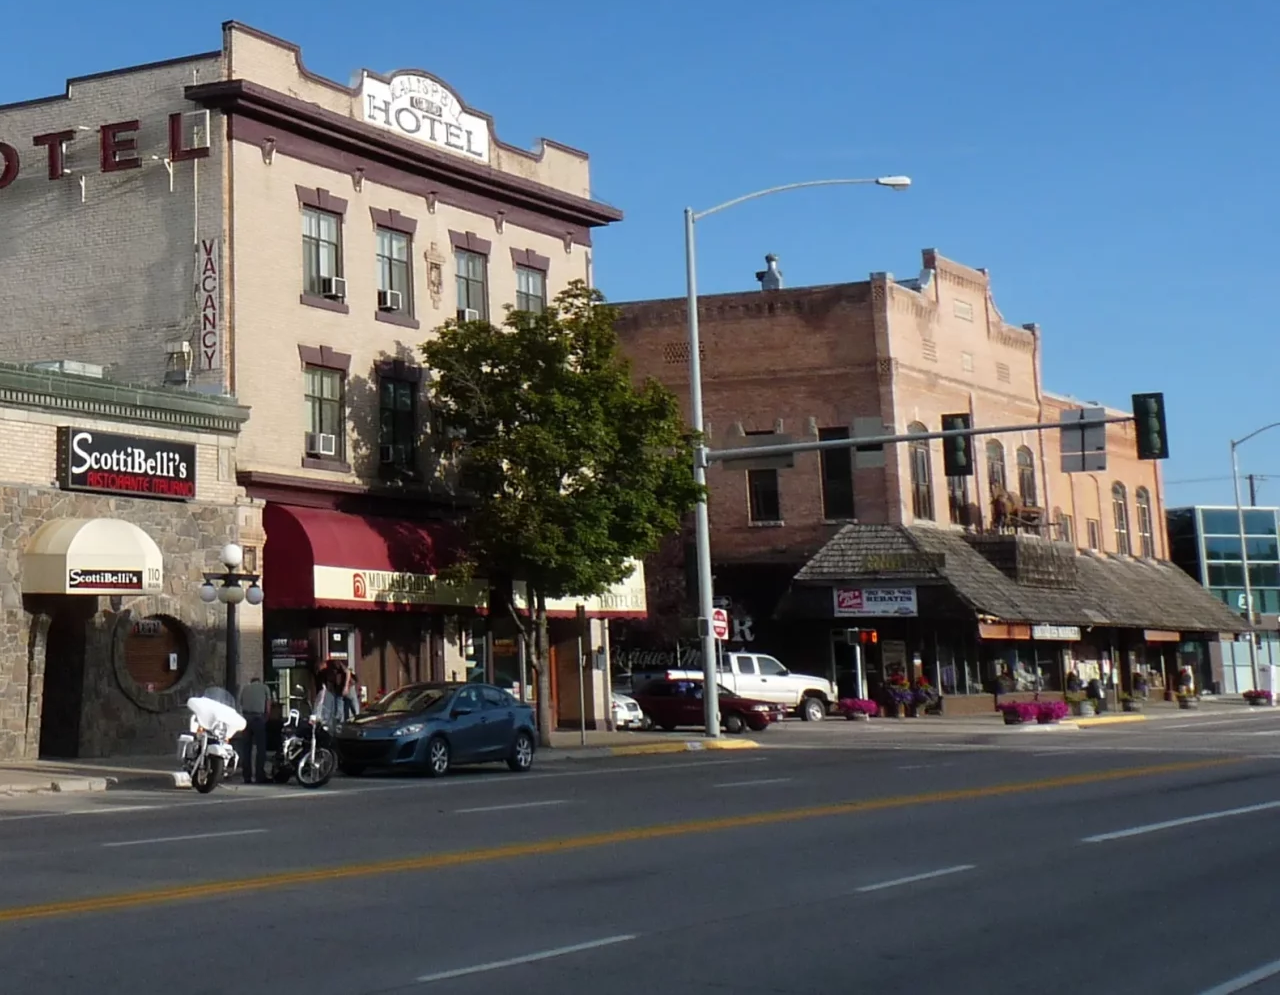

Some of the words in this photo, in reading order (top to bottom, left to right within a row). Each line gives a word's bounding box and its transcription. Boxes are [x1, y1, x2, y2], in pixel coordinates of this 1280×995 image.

[367, 94, 483, 158] HOTEL
[201, 239, 218, 371] VACANCY
[71, 432, 187, 479] ScottiBelli's
[87, 472, 149, 492] RISTORANTE
[69, 569, 138, 585] ScottiBelli's
[148, 568, 160, 581] 110
